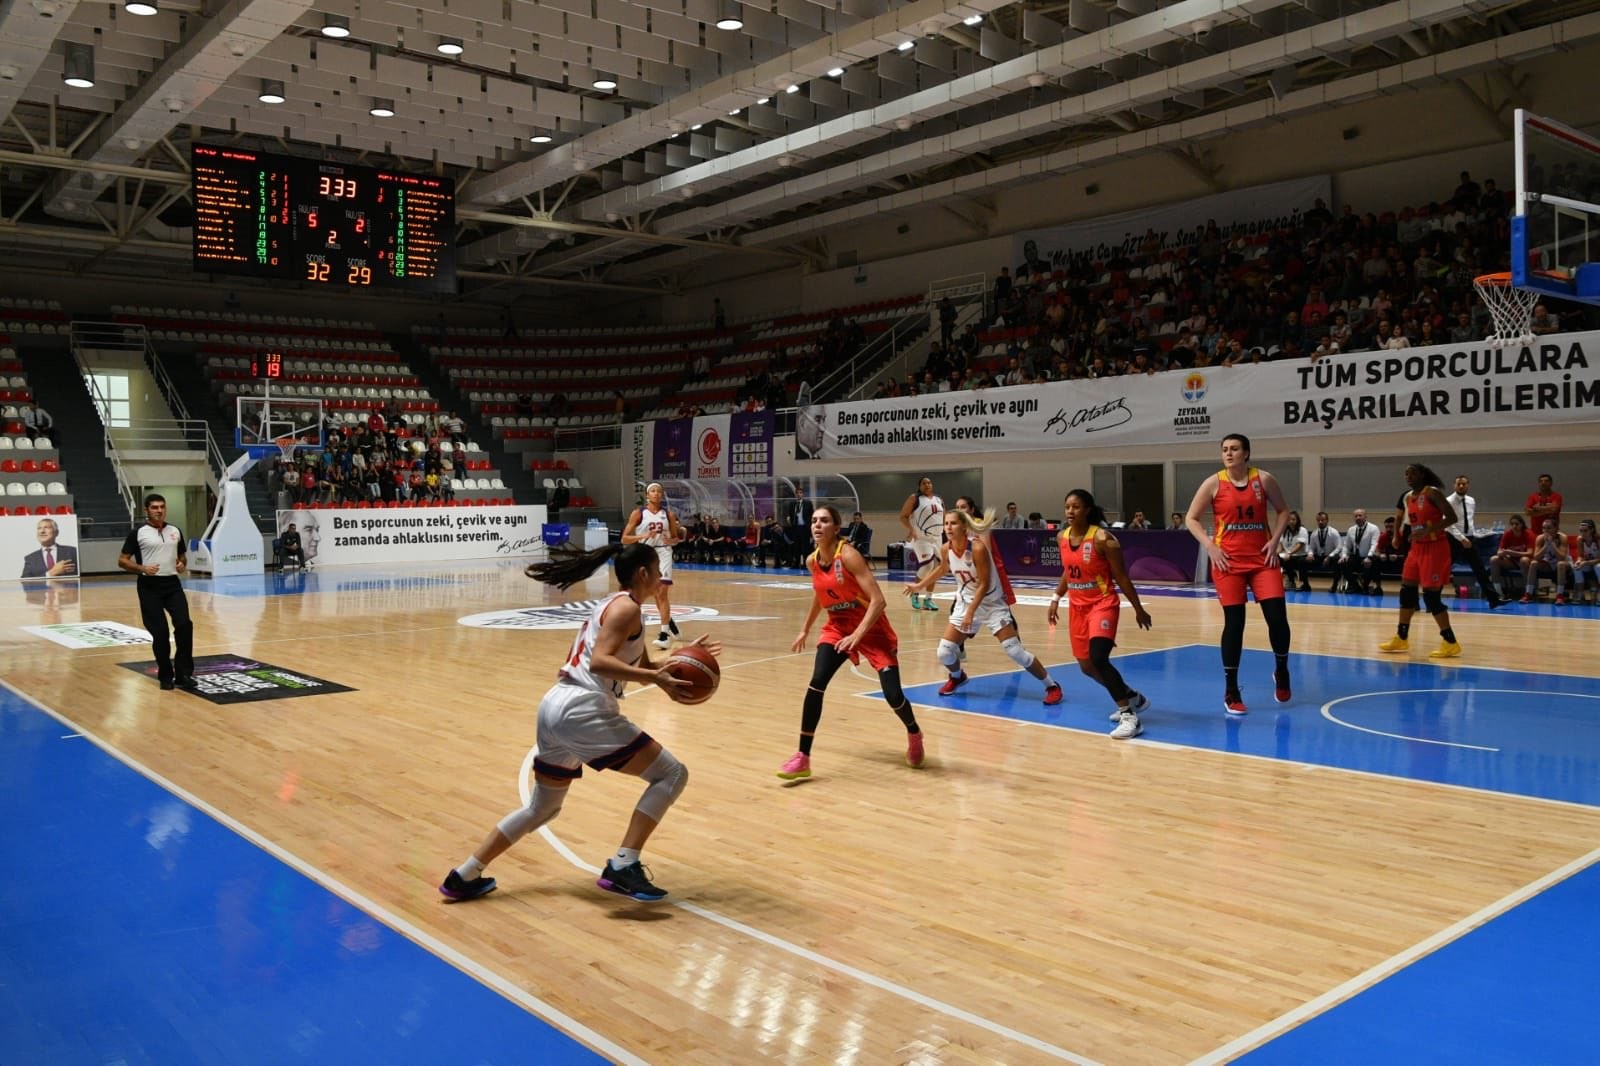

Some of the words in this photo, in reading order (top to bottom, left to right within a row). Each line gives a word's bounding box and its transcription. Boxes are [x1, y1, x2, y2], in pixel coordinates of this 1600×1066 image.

[308, 213, 317, 227] 5
[356, 220, 364, 232] 2
[328, 230, 337, 244] 2
[307, 262, 330, 281] 32
[348, 266, 371, 284] 29
[268, 363, 280, 376] 19
[1297, 358, 1356, 390] TÜM
[1366, 342, 1589, 384] SPORCULARA
[1283, 390, 1450, 429] BAŞARILAR
[1460, 374, 1600, 413] DİLERİM
[838, 409, 858, 425] Ben
[860, 406, 919, 426] sporcunun
[922, 403, 950, 422] zeki,
[953, 400, 988, 420] çevik
[990, 402, 1006, 414] ve
[1008, 398, 1038, 418] aynı
[1178, 406, 1208, 416] ZEYDAN
[1174, 416, 1211, 426] KARALAR
[837, 428, 886, 446] zamanda
[887, 425, 948, 444] ahlaklısını
[950, 422, 1006, 440] severim.
[1237, 506, 1254, 519] 14
[334, 517, 358, 529] Ben
[361, 518, 424, 531] sporcunun
[426, 516, 453, 528] zeki,
[456, 514, 486, 529] çevik
[488, 516, 501, 526] ve
[504, 515, 528, 529] aynı
[649, 522, 663, 534] 23
[335, 532, 390, 546] zamanda
[392, 532, 454, 544] ahlaklısını
[456, 529, 503, 542] severim.
[955, 570, 976, 582] 77
